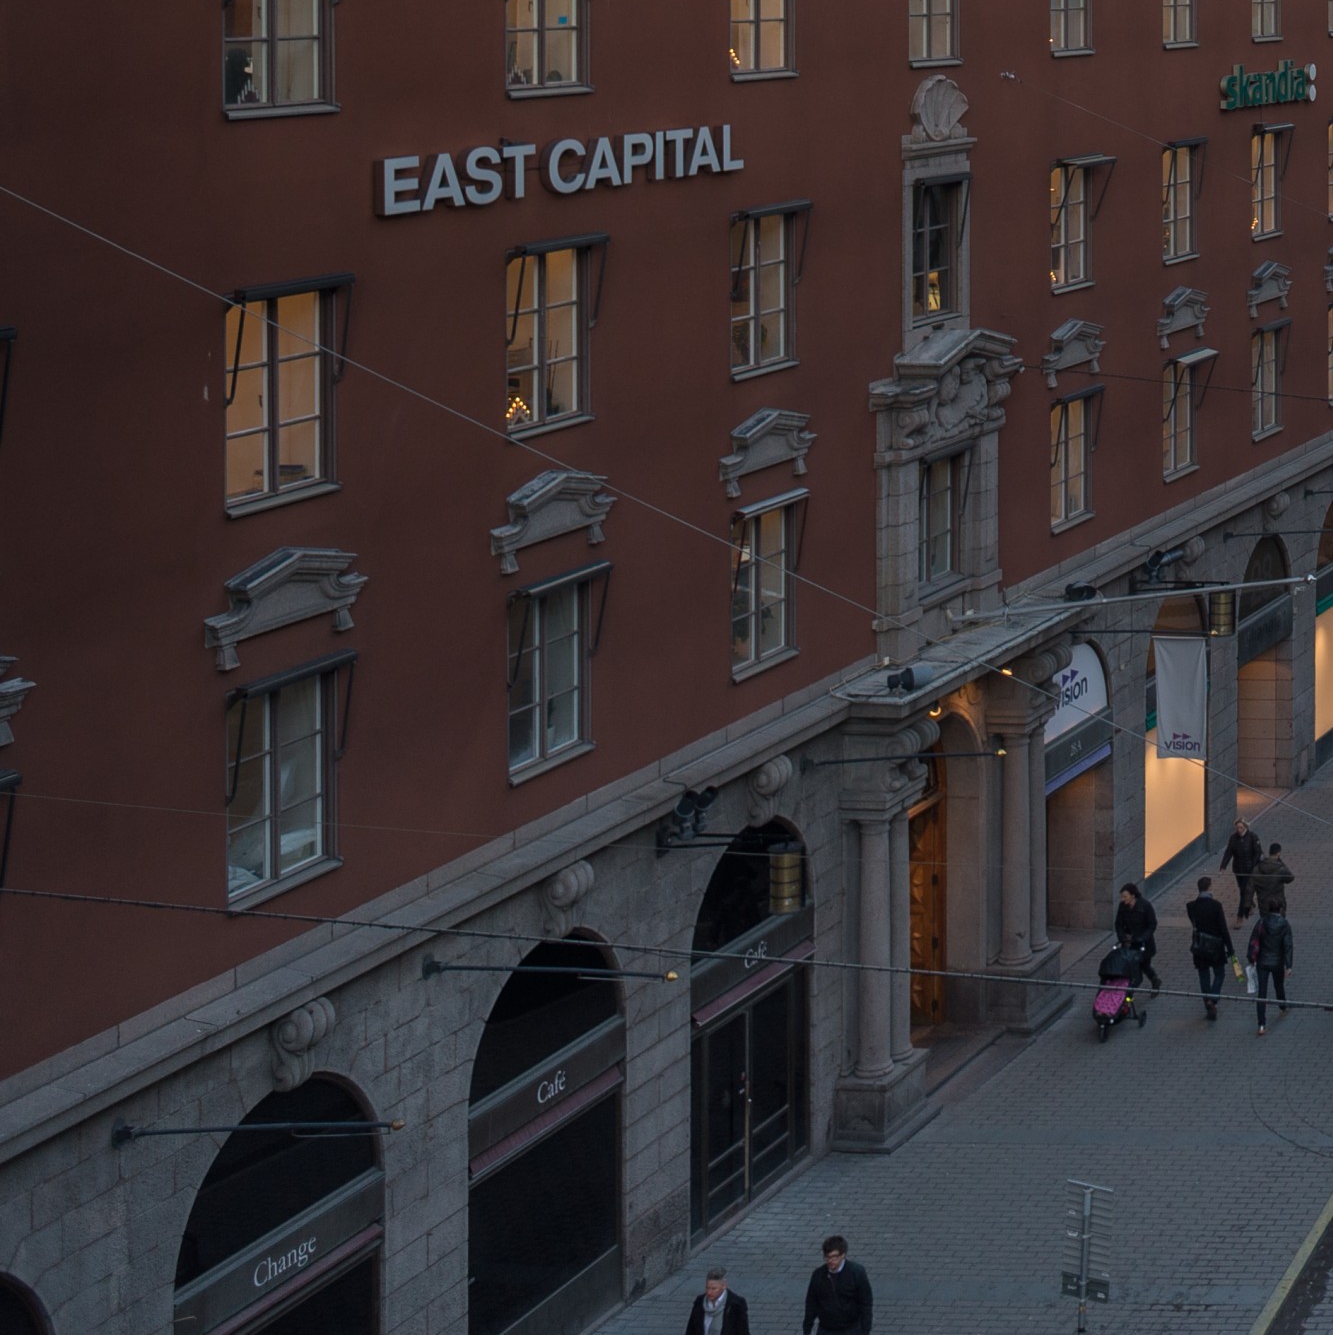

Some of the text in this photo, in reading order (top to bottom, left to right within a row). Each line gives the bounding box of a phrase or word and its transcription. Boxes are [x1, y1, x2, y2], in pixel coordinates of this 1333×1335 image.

[380, 124, 744, 217] EAST CAPITAL
[1164, 741, 1201, 752] vision
[744, 940, 768, 969] Café
[537, 1070, 566, 1104] Café
[253, 1236, 317, 1287] Change
